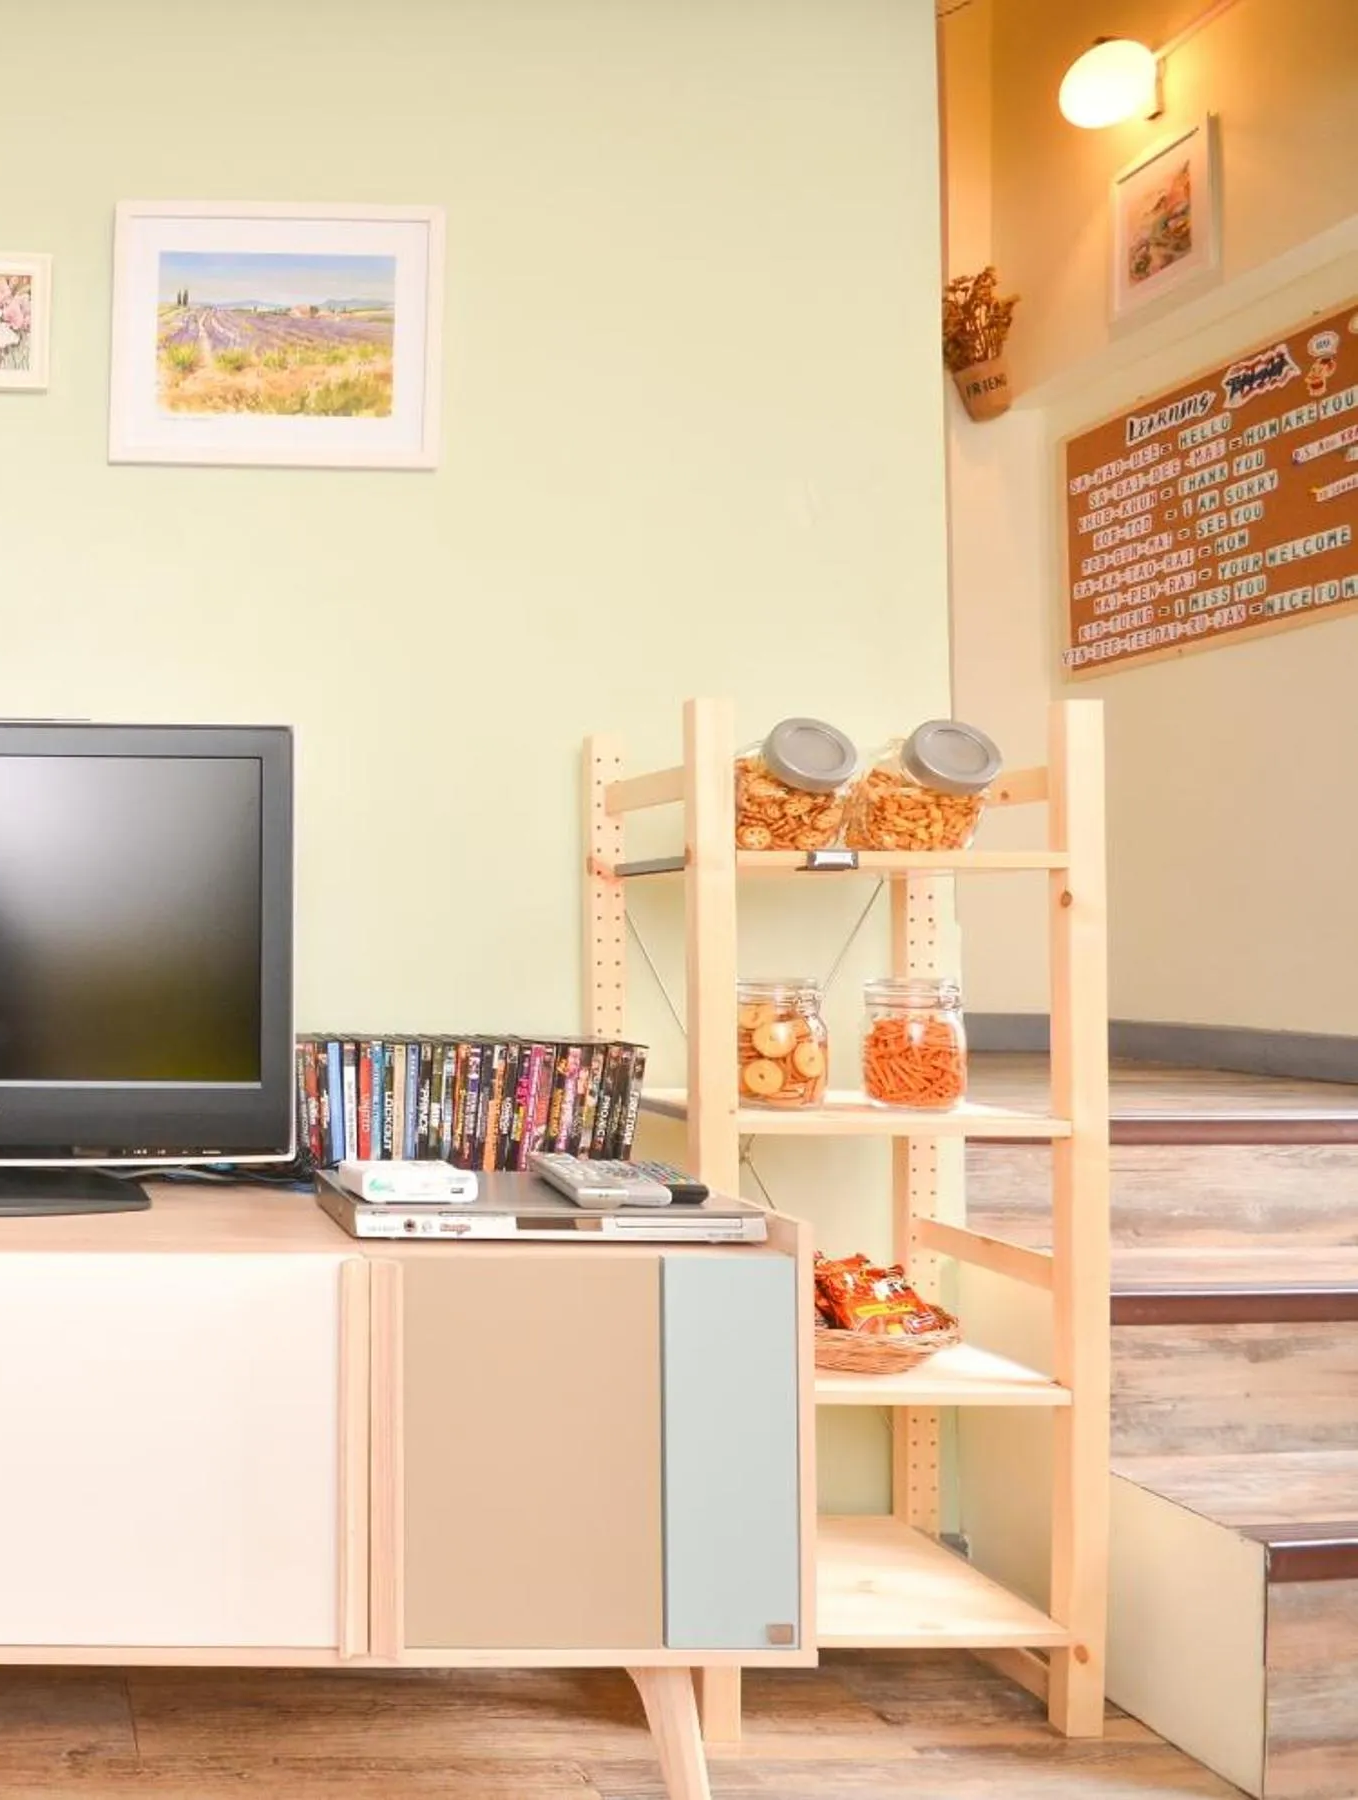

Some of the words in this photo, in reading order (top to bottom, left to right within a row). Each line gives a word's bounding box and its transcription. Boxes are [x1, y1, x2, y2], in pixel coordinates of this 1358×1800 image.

[1245, 421, 1279, 445] HOW
[1283, 407, 1316, 429] ARE
[1321, 389, 1355, 416] YOU
[1235, 452, 1264, 473] YOU
[1226, 473, 1276, 503] SORRY
[1198, 517, 1226, 538] SEE
[1233, 504, 1263, 524] YOU
[1220, 554, 1262, 579] YOUR
[1267, 529, 1350, 565] WELCOME
[1191, 588, 1229, 608] MISS
[1235, 578, 1265, 598] YOU
[1266, 588, 1311, 614] NICE
[1317, 582, 1338, 603] TO
[383, 1091, 394, 1153] LOCKOUT
